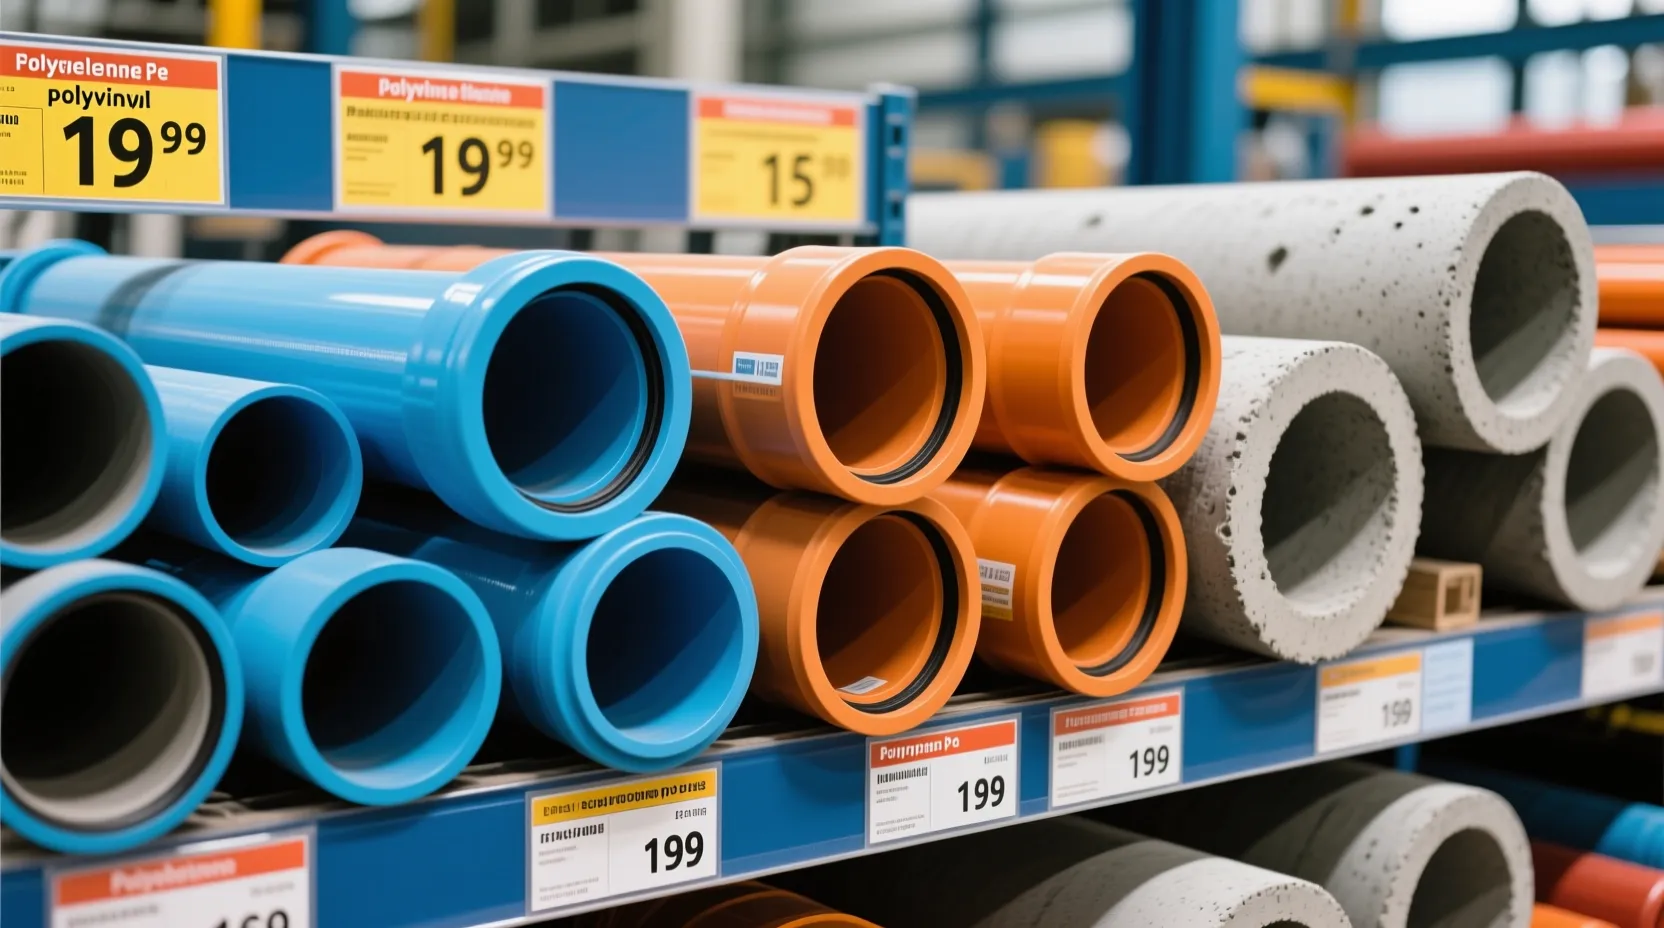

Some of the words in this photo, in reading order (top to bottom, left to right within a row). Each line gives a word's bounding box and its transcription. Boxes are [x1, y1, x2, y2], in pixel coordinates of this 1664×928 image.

[146, 62, 169, 81] Pe
[63, 116, 153, 188] 19
[160, 121, 206, 155] 99
[422, 135, 490, 197] 19
[497, 138, 534, 169] 99
[763, 153, 815, 207] 15
[1129, 744, 1170, 778] 199
[958, 775, 1005, 812] 199
[644, 830, 704, 874] 199
